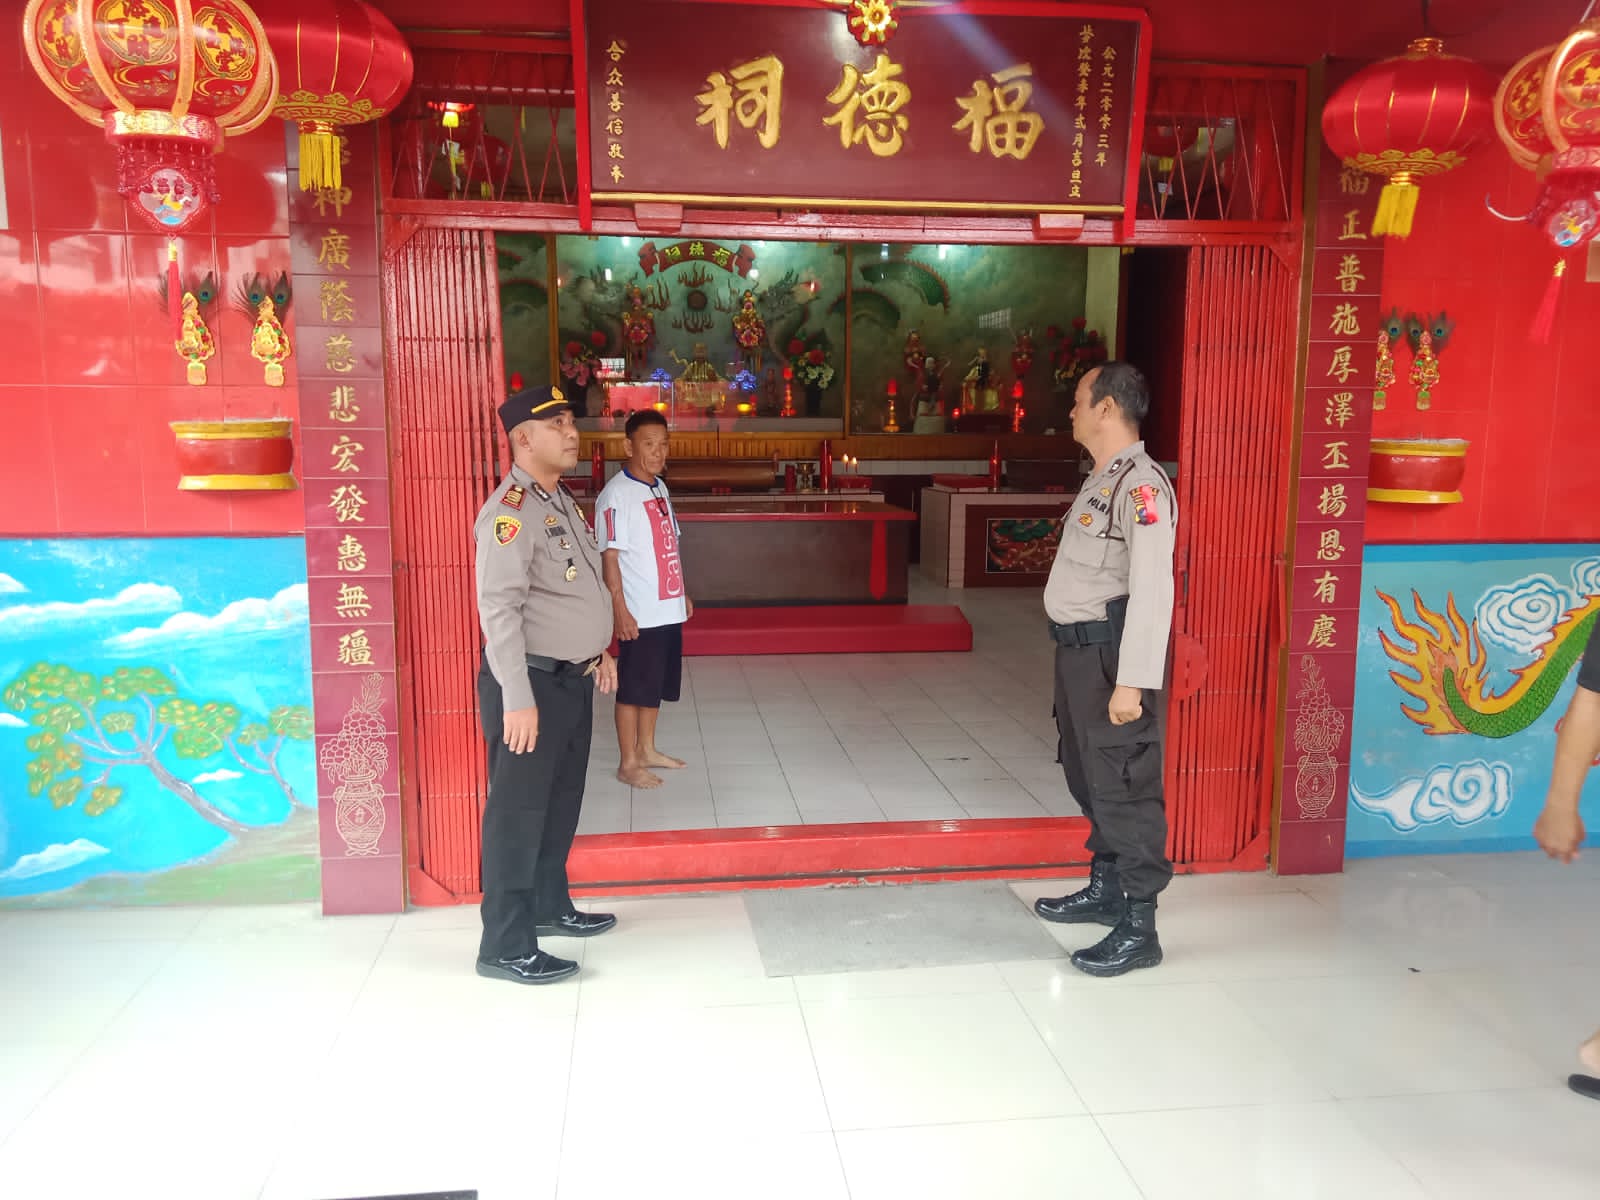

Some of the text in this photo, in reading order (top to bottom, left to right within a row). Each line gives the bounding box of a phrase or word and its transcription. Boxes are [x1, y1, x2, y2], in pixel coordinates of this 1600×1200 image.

[695, 51, 1046, 160] 福德祠
[313, 128, 376, 667] 神廣蔭慈悲宏發惠無疆
